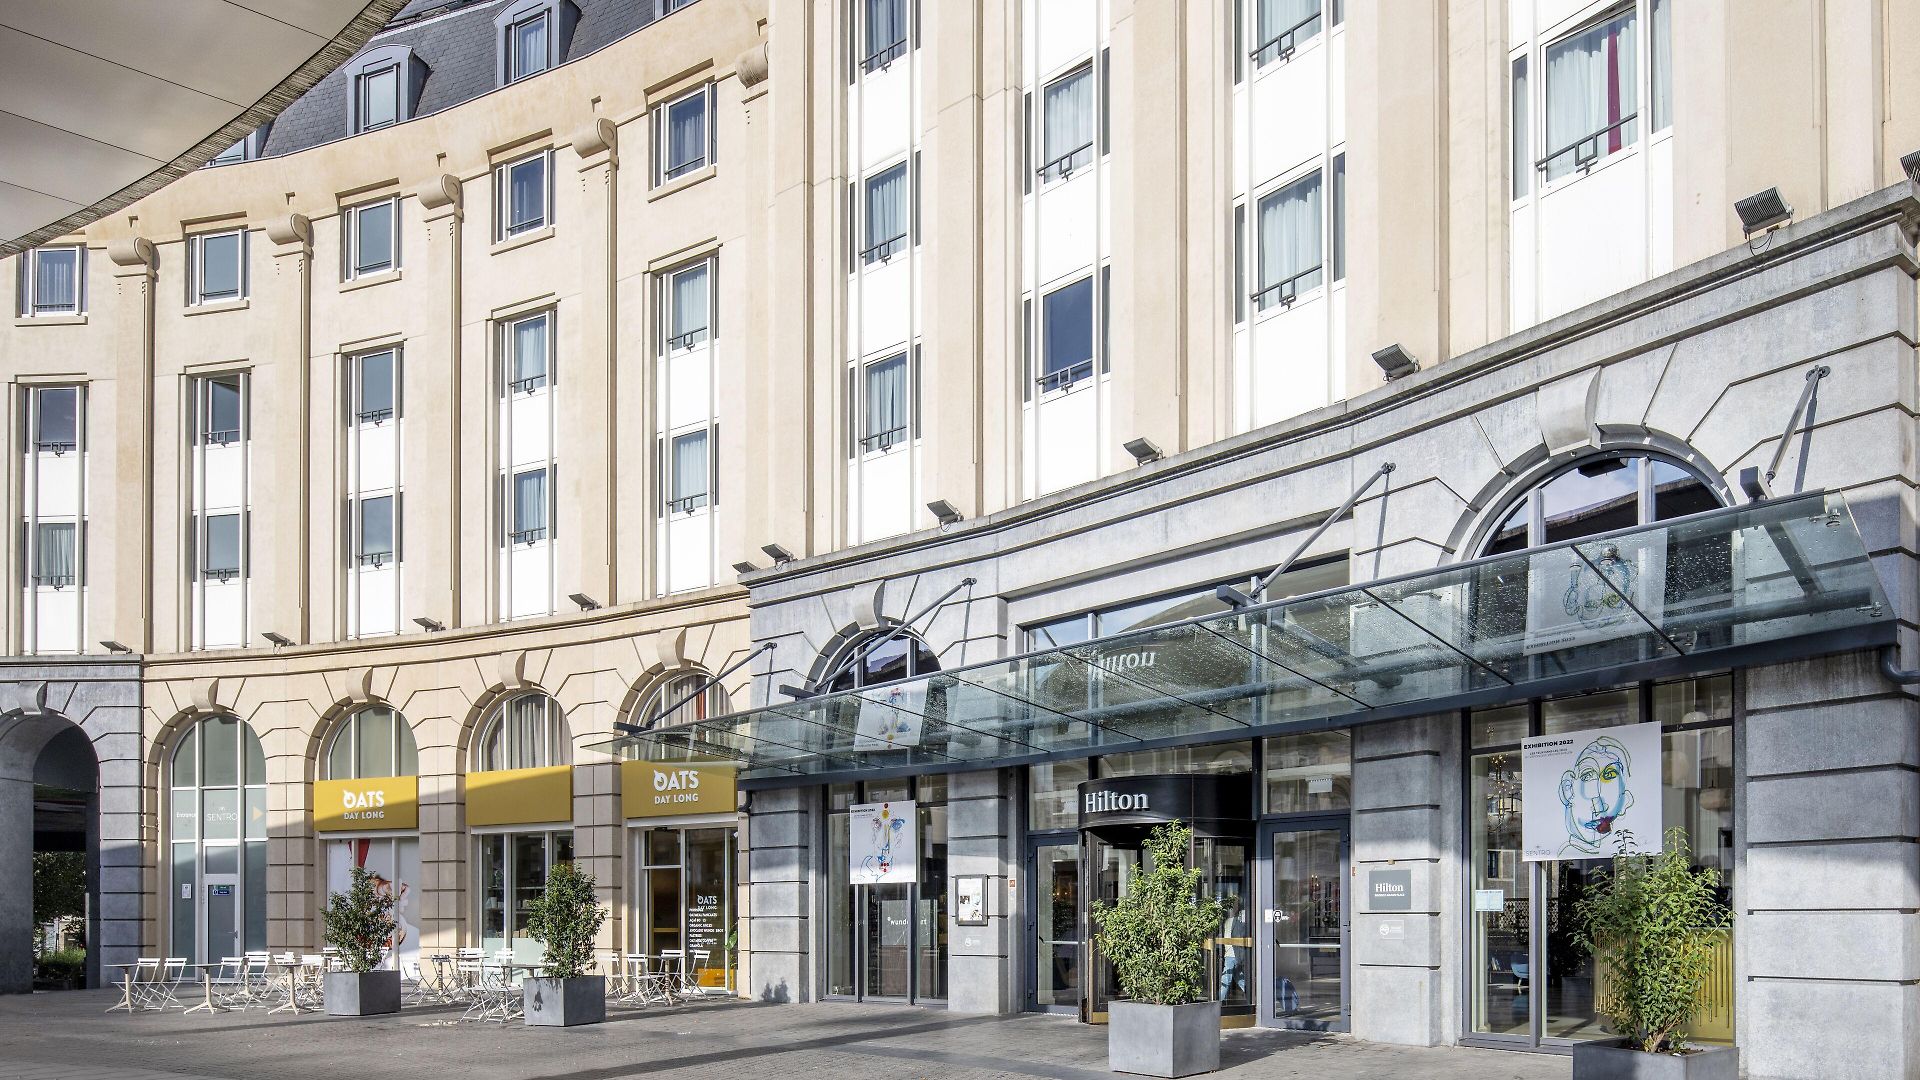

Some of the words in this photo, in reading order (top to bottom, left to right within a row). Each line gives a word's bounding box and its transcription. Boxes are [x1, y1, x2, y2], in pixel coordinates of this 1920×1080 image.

[1523, 741, 1558, 750] EXHIBITION
[654, 769, 699, 792] OATS
[343, 789, 385, 809] OATS
[654, 795, 670, 804] DAY
[673, 793, 699, 803] LONG
[1085, 790, 1150, 813] Hilton
[207, 813, 238, 821] SENTRO
[344, 812, 360, 820] DAY
[361, 811, 385, 819] LONG
[1375, 882, 1404, 892] Hilton
[697, 895, 717, 904] OATS
